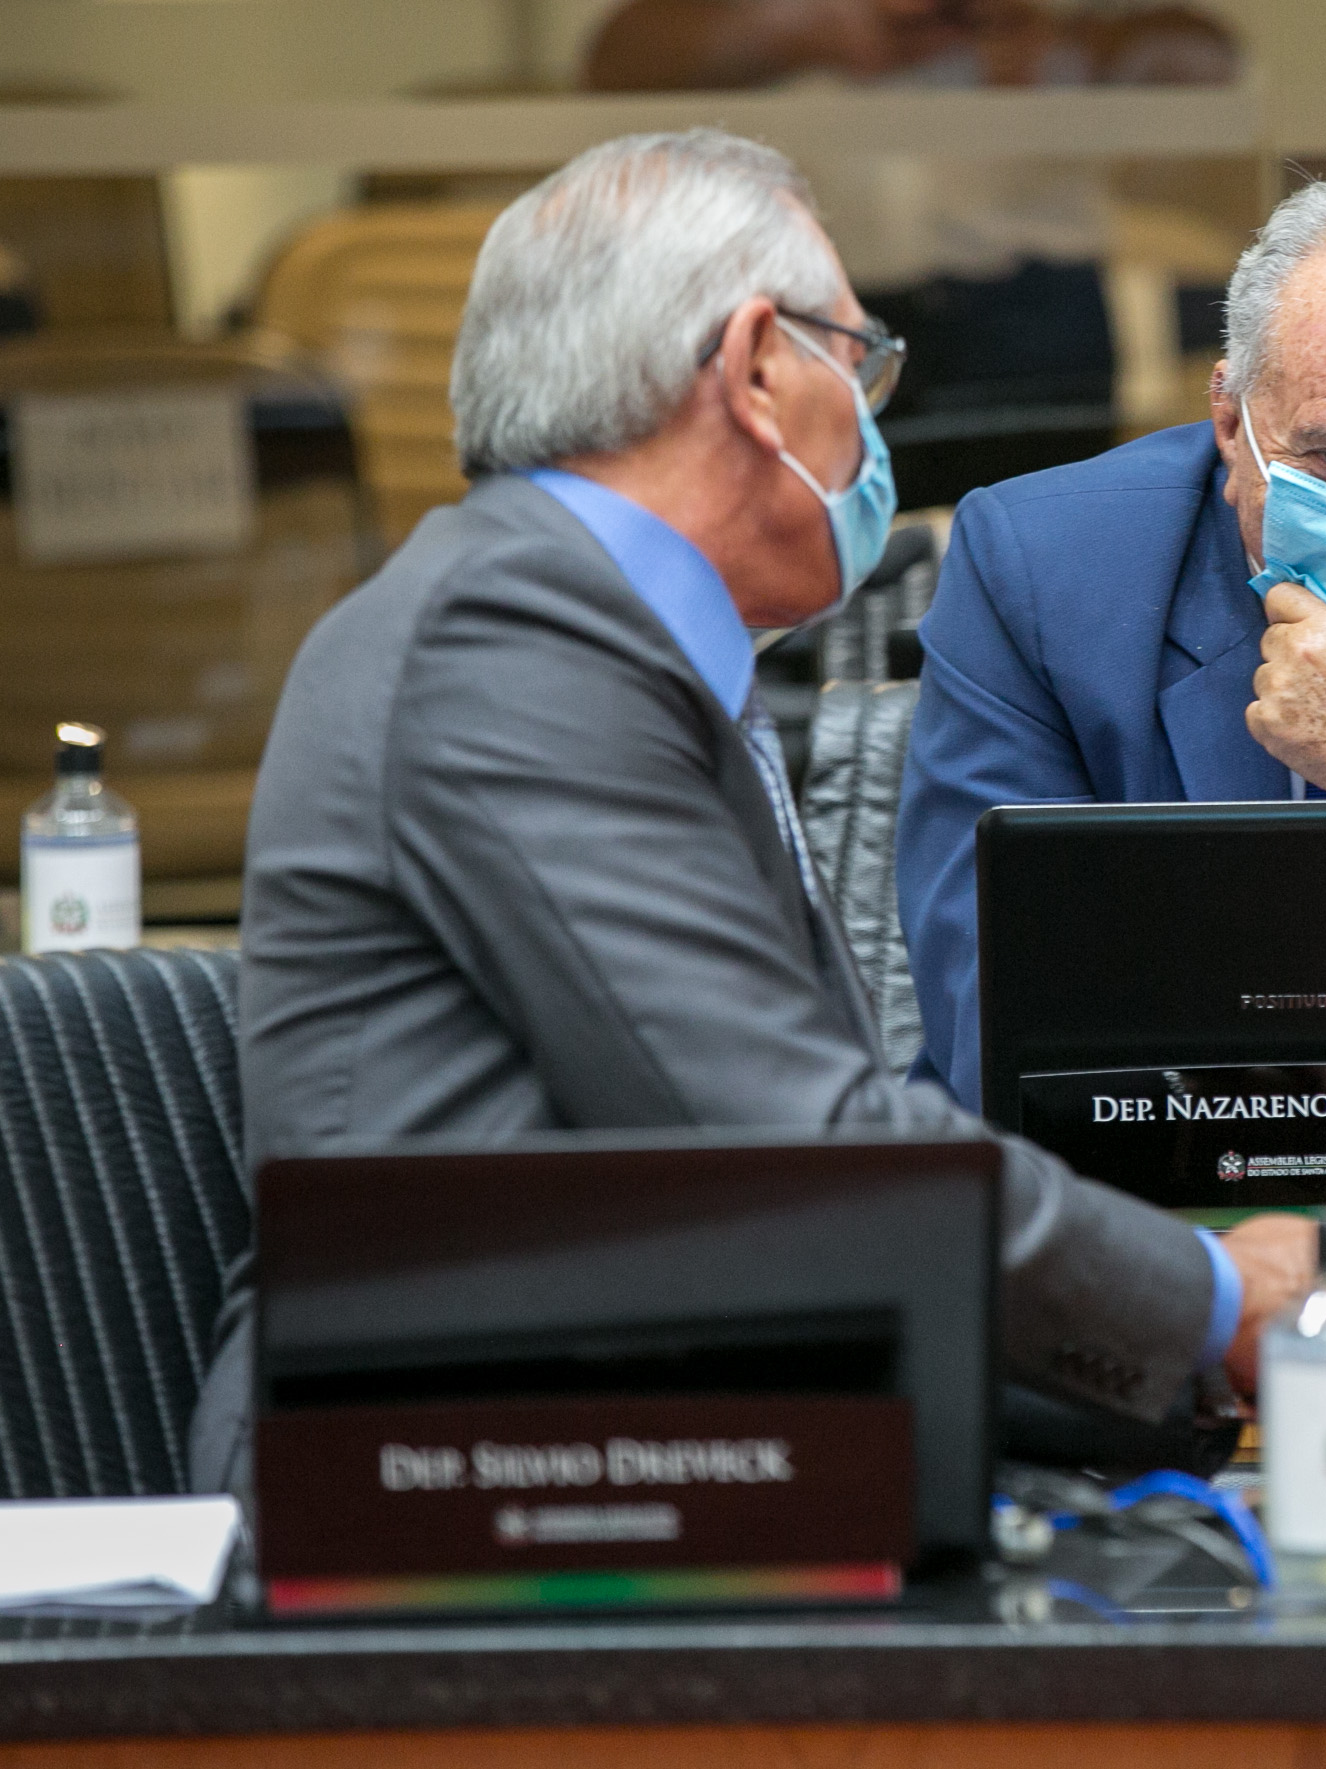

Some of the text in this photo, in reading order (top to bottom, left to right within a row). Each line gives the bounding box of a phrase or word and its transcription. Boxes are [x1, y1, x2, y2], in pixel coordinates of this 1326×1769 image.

[1091, 1096, 1156, 1122] DEP.
[1247, 1155, 1302, 1167] ASSEMBLEIA
[1246, 1168, 1260, 1177] DO
[1261, 1168, 1289, 1177] ESTADO
